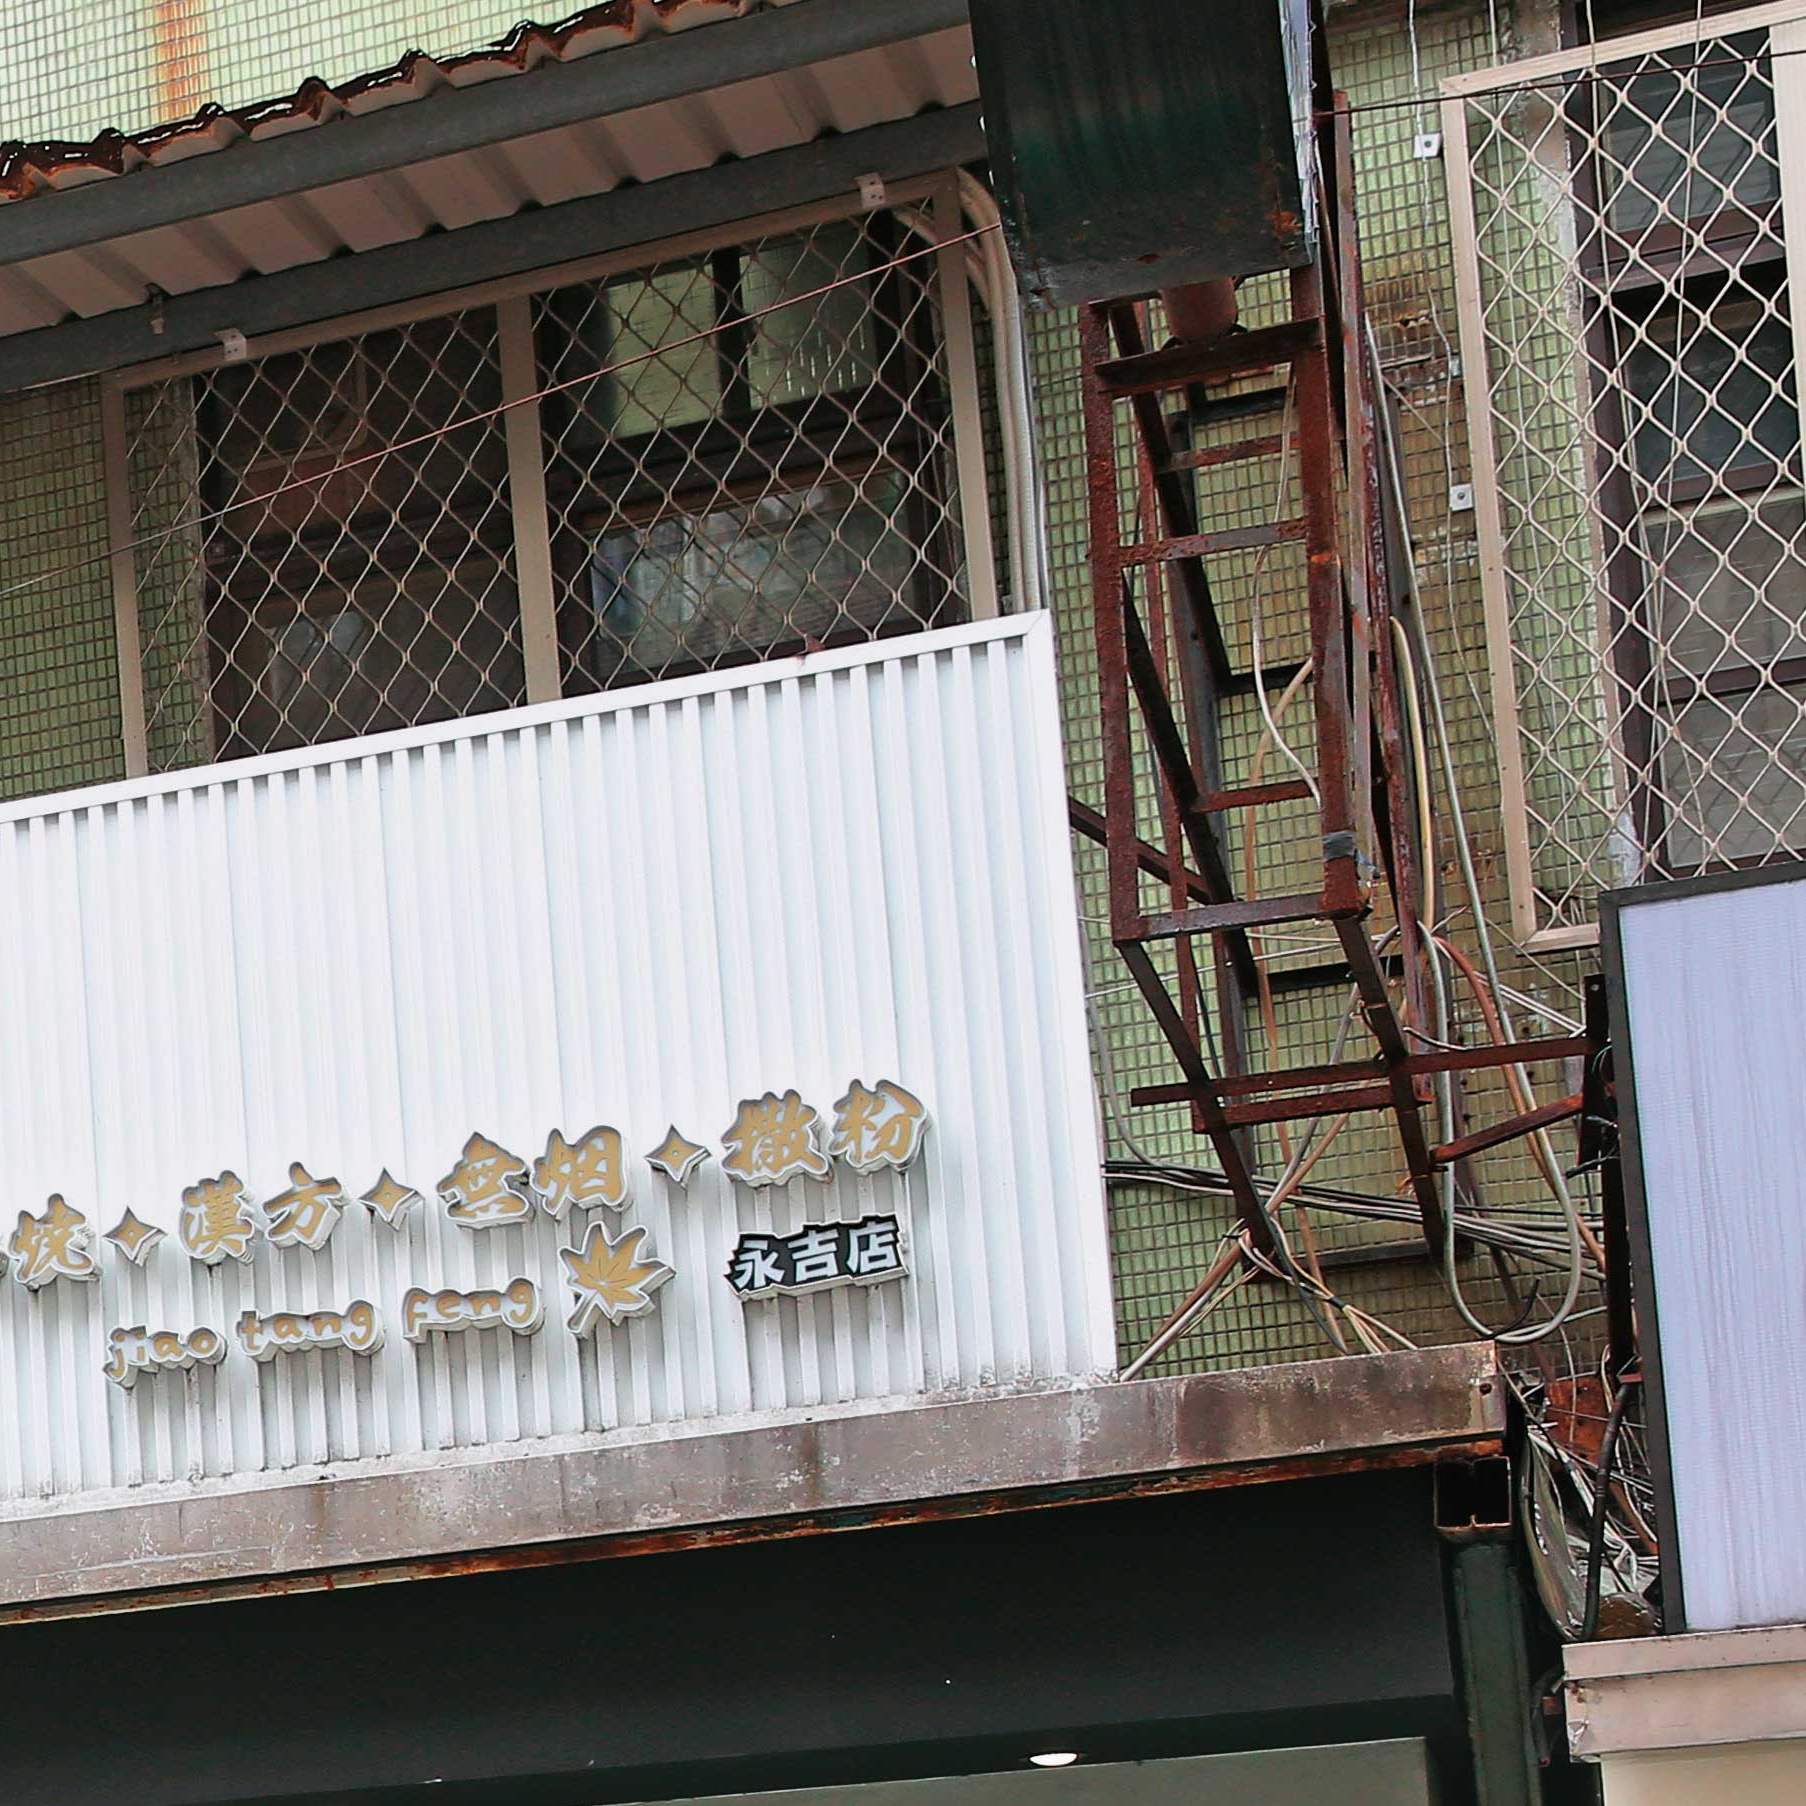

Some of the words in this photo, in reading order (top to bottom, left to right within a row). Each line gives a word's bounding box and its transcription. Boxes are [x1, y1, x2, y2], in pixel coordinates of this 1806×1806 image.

[181, 1162, 343, 1265] 漢方
[735, 1221, 899, 1291] 永吉店
[106, 1329, 219, 1380] jiao
[239, 1302, 375, 1353] tang
[404, 1279, 537, 1332] feng
